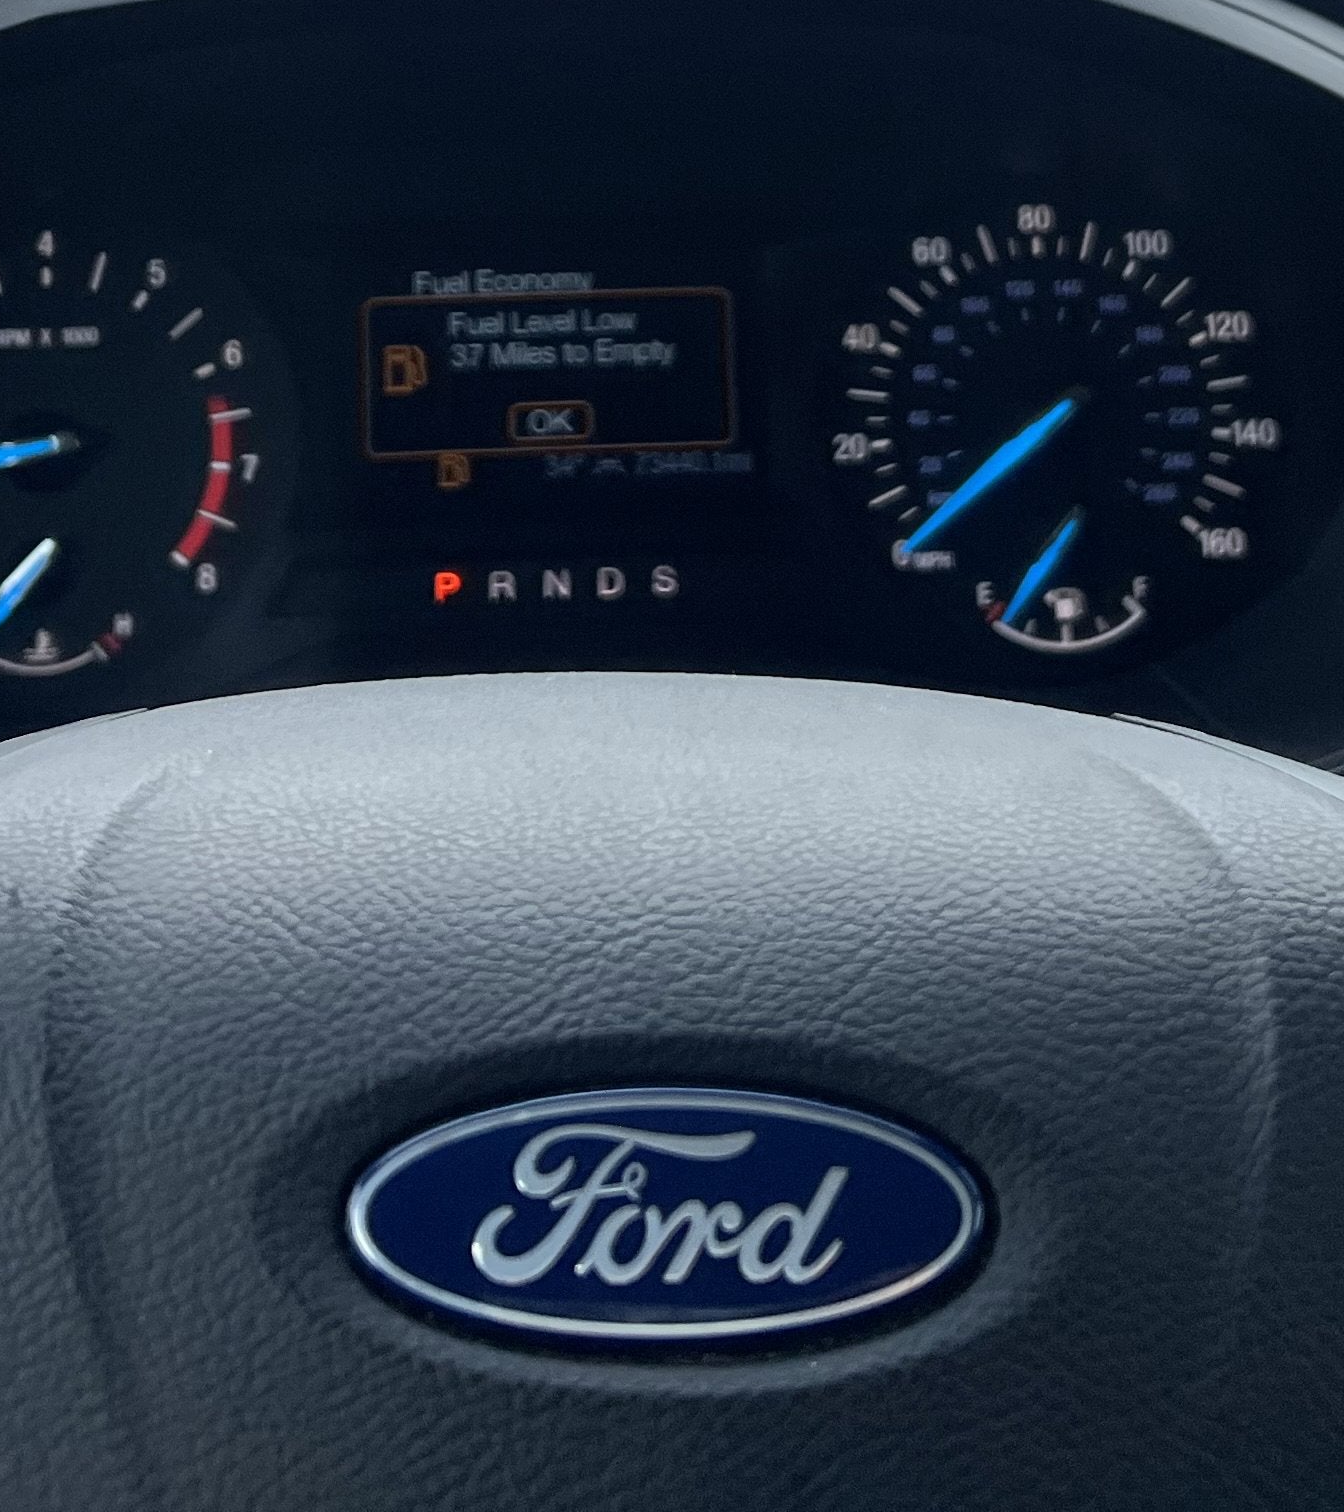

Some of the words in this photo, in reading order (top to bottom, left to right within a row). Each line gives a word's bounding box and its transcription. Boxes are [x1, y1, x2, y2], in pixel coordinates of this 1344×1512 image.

[1016, 204, 1052, 232] 80
[36, 230, 56, 257] 4
[911, 236, 950, 264] 60
[1123, 230, 1170, 257] 100
[146, 259, 167, 286] 5
[412, 270, 470, 295] Fuel
[474, 268, 595, 293] Economy
[448, 311, 504, 335] Fuel
[509, 309, 577, 334] Level
[581, 308, 637, 331] Low
[1205, 312, 1252, 339] 120
[843, 323, 881, 351] 40
[222, 339, 243, 366] 6
[489, 341, 557, 365] Miles
[561, 343, 591, 364] to
[593, 338, 675, 366] Empty
[525, 408, 576, 434] OK
[1232, 418, 1279, 449] 140
[832, 432, 868, 463] 20
[241, 453, 258, 483] 7
[1199, 528, 1247, 560] 160
[434, 571, 461, 602] P
[488, 570, 516, 601] R
[543, 568, 572, 599] N
[596, 566, 626, 599] D
[651, 564, 680, 598] S
[470, 1122, 850, 1286] Ford
